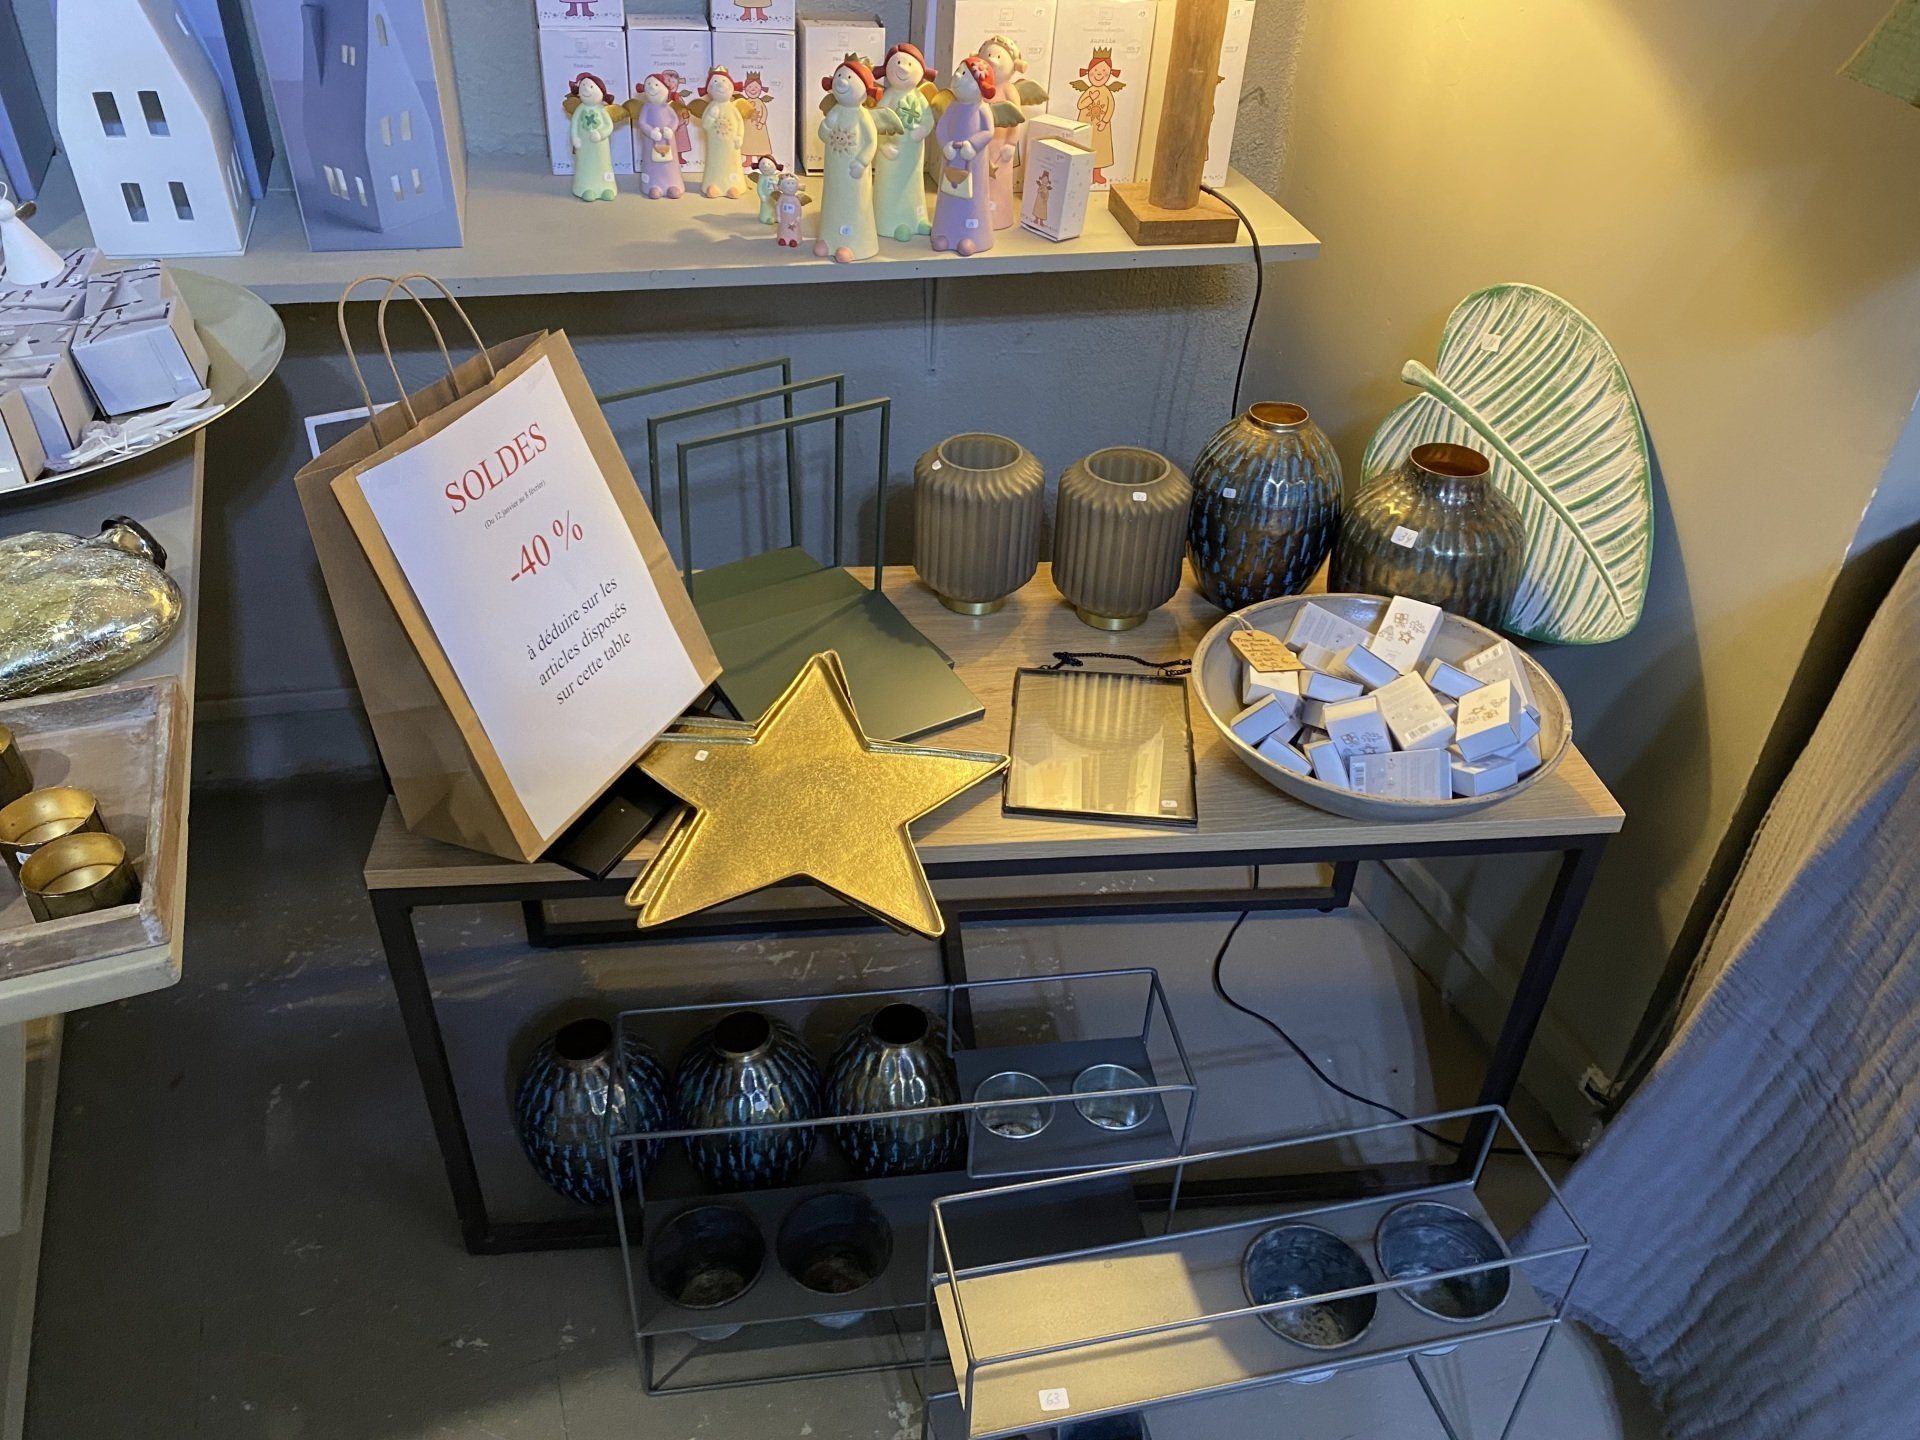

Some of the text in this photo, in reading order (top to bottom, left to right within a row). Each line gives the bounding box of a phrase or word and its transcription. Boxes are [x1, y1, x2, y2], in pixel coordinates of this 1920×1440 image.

[445, 421, 548, 515] SOLDES
[484, 519, 496, 530] (Du
[494, 511, 502, 521] 12
[501, 501, 519, 518] janvier
[511, 509, 584, 582] -40 %
[527, 578, 618, 661] à déduire sur les
[538, 602, 628, 686] articles disposés
[556, 632, 632, 705] sur cette table
[1046, 1392, 1061, 1406] 63
